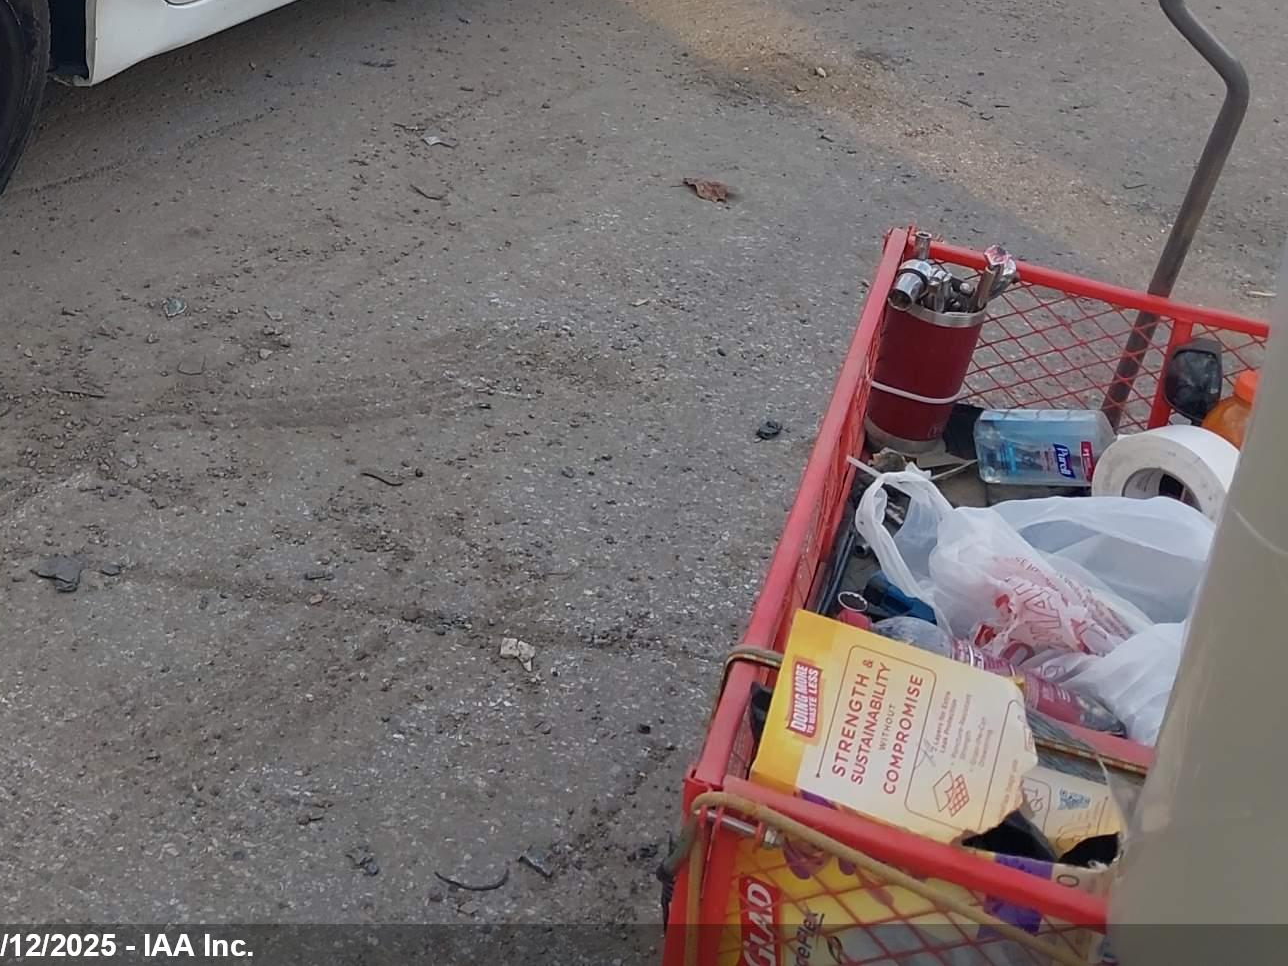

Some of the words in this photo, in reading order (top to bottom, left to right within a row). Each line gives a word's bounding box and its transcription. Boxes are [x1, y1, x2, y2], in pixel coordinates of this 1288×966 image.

[794, 663, 809, 694] MORE
[807, 669, 819, 693] LESS
[790, 693, 809, 732] DOING
[806, 724, 815, 734] TO
[808, 696, 818, 724] WASTE
[832, 673, 870, 777] STRENGTH
[862, 659, 874, 669] &
[851, 662, 891, 785] SUSTAINABILITY
[879, 704, 896, 751] WITHOUT
[883, 674, 923, 795] COMPROMISE
[743, 883, 777, 966] GLAD
